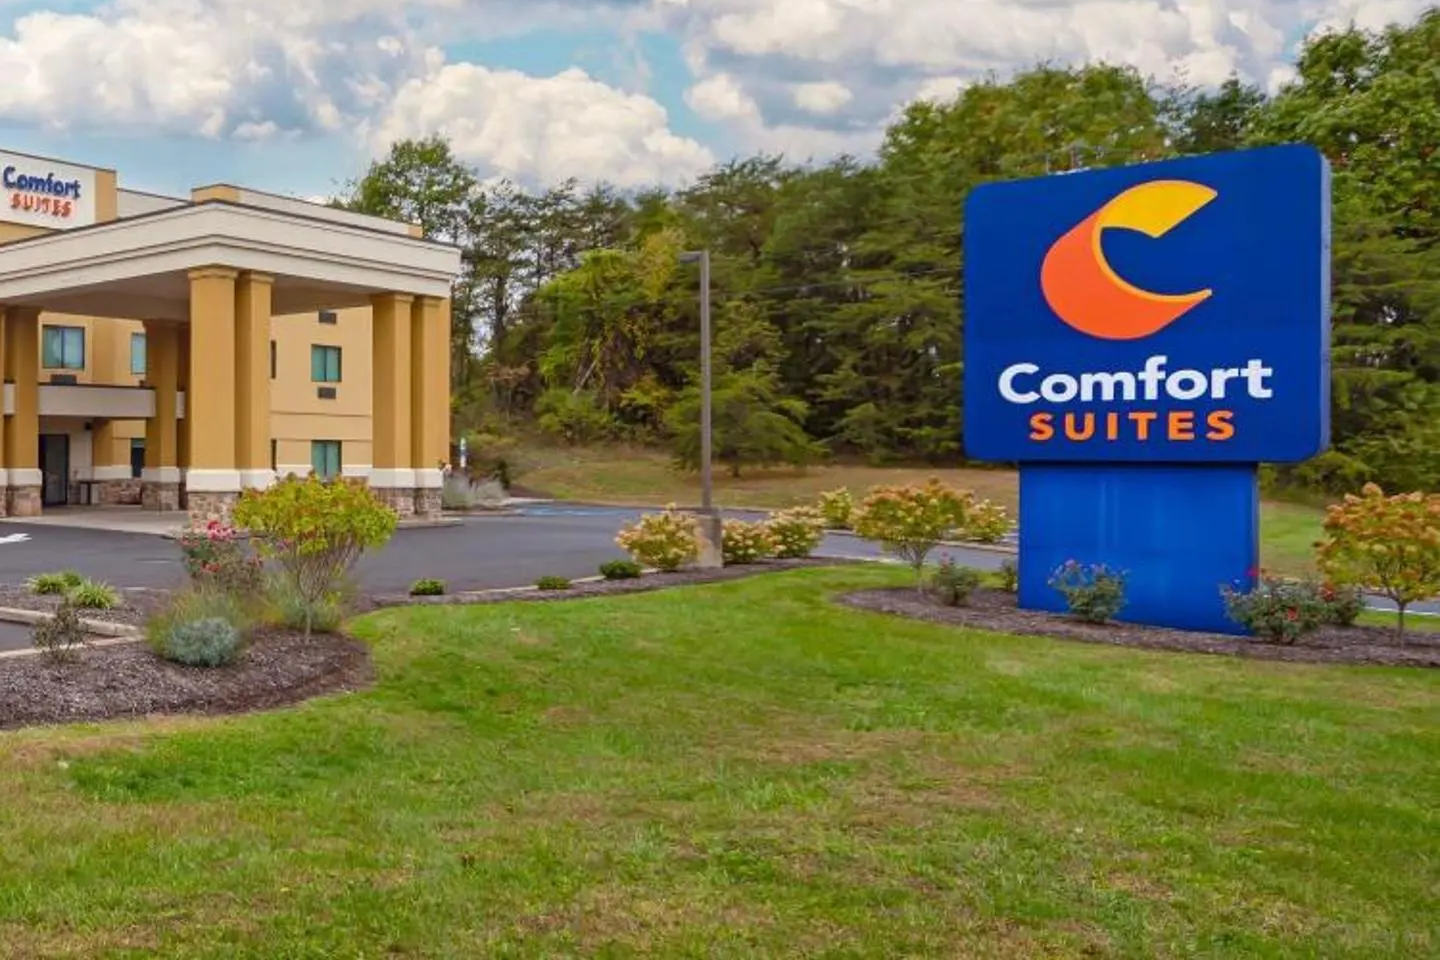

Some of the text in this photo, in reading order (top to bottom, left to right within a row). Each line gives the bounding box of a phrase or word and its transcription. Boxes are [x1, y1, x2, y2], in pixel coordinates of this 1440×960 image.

[2, 165, 81, 199] Comfort
[11, 192, 72, 218] SUITES
[998, 355, 1273, 403] Comfort
[1029, 410, 1235, 441] SUITES
